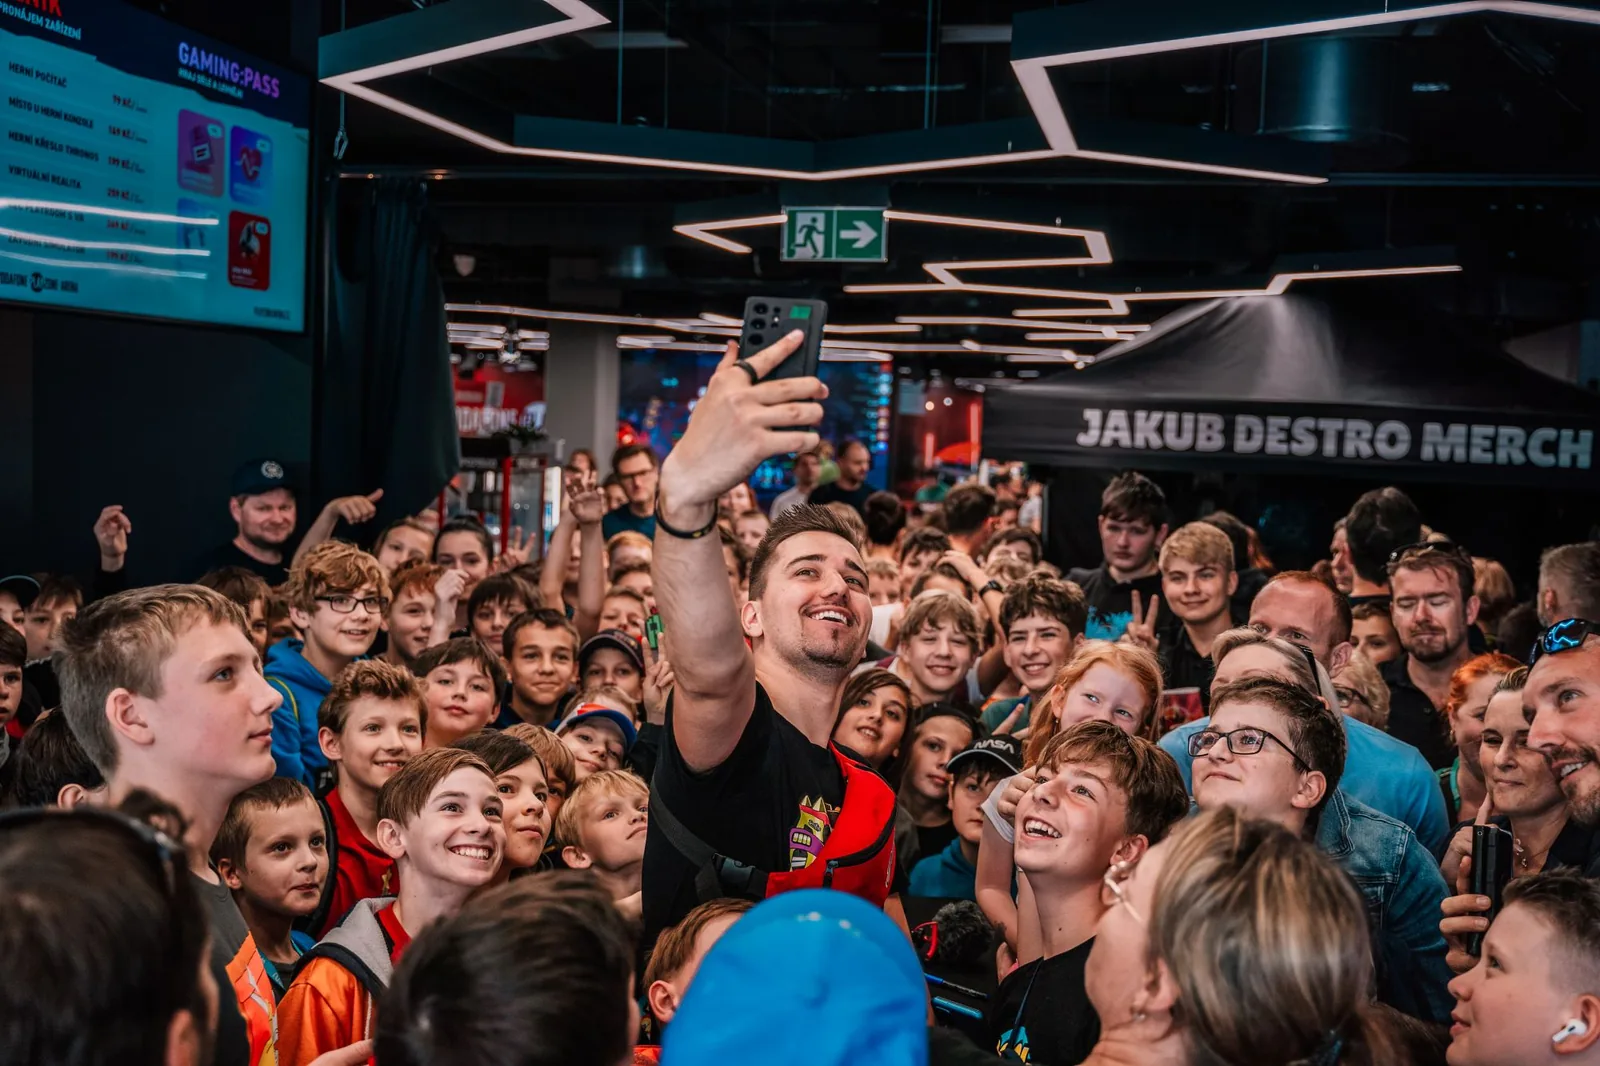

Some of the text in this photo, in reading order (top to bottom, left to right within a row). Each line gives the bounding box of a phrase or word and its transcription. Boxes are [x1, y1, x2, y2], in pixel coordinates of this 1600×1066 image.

[9, 61, 67, 88] HERNÍ POČÍTAČ
[178, 41, 280, 98] GAMING:PASS
[9, 96, 32, 111] MÍSTO
[8, 130, 33, 145] HERNÍ
[8, 165, 81, 189] VIRTUÁLNÍ REALITA
[1076, 408, 1594, 470] JAKUB DESTRO MERCH
[973, 739, 1015, 755] NASA
